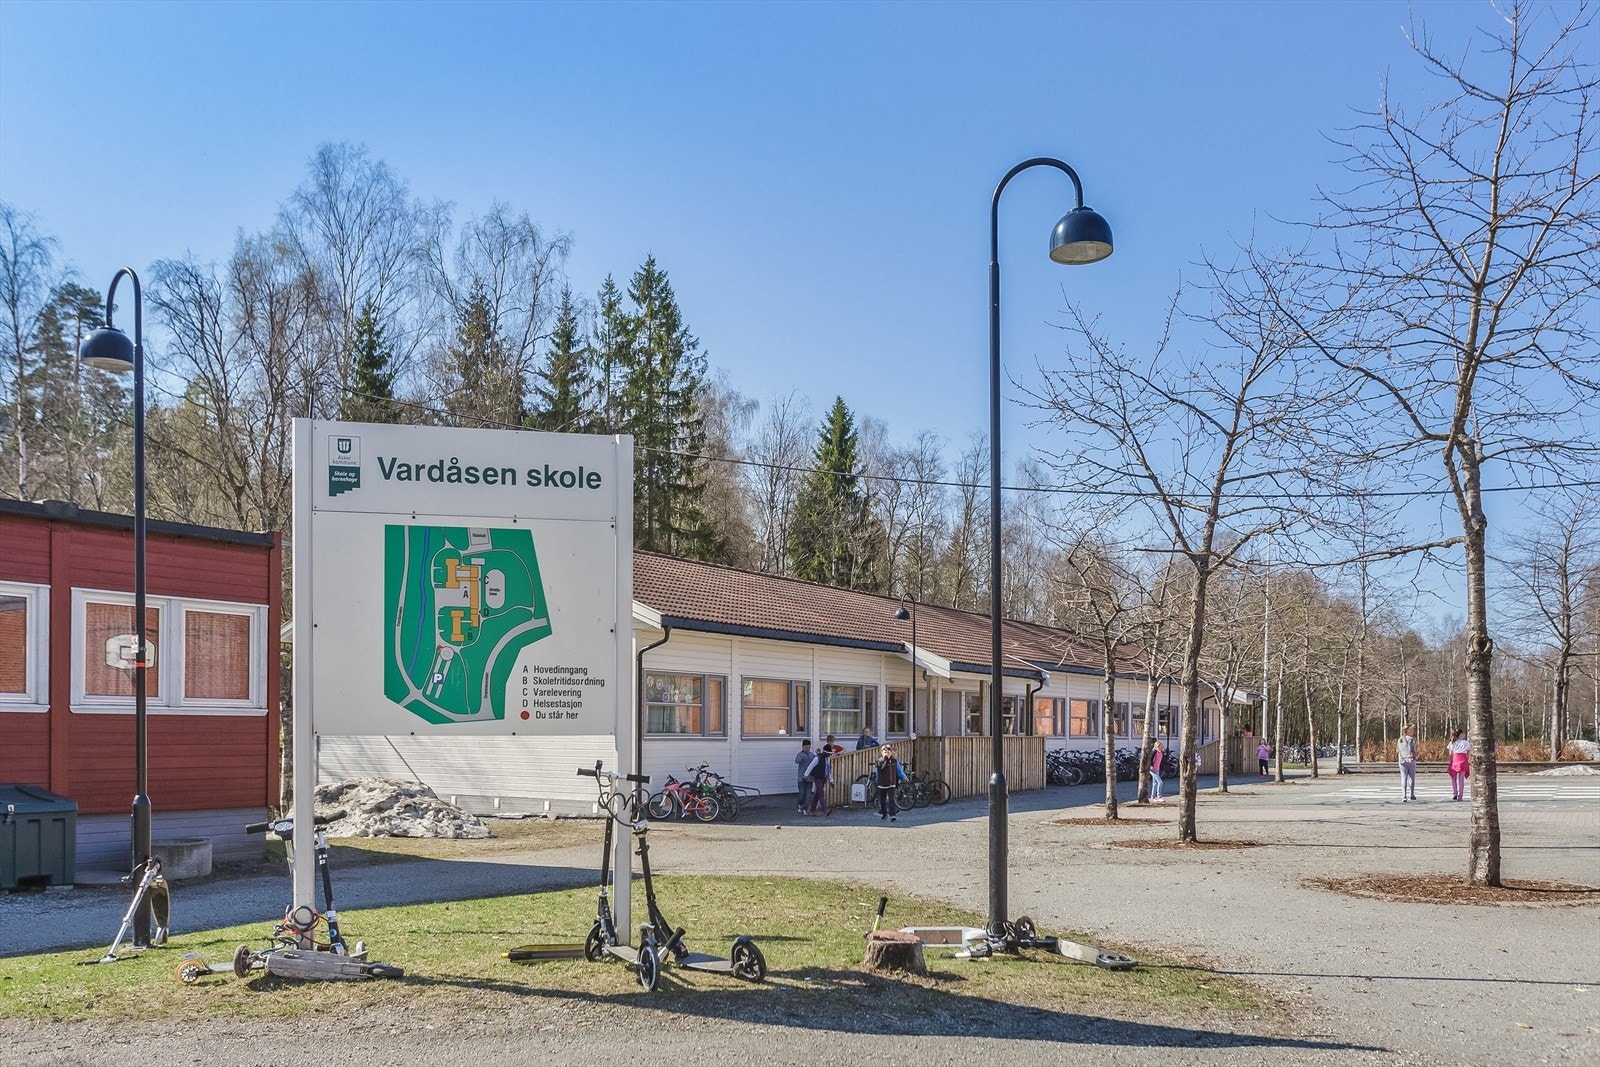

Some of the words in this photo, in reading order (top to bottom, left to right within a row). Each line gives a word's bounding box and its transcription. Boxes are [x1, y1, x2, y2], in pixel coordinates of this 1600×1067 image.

[377, 456, 517, 486] Vardåsen
[526, 464, 602, 490] skole
[484, 576, 490, 585] C
[463, 590, 469, 599] A
[484, 608, 490, 617] D
[468, 632, 473, 641] B
[522, 665, 528, 673] A
[533, 665, 588, 676] Hovedinngang
[434, 673, 444, 683] P
[522, 676, 528, 685] B
[533, 676, 605, 687] Skolefritidsordning
[522, 688, 528, 696] C
[533, 688, 582, 698] Varelevering
[522, 699, 528, 707] D
[533, 699, 582, 709] Helsestasjon
[536, 711, 546, 719] Du
[548, 710, 563, 719] står
[566, 711, 578, 719] her
